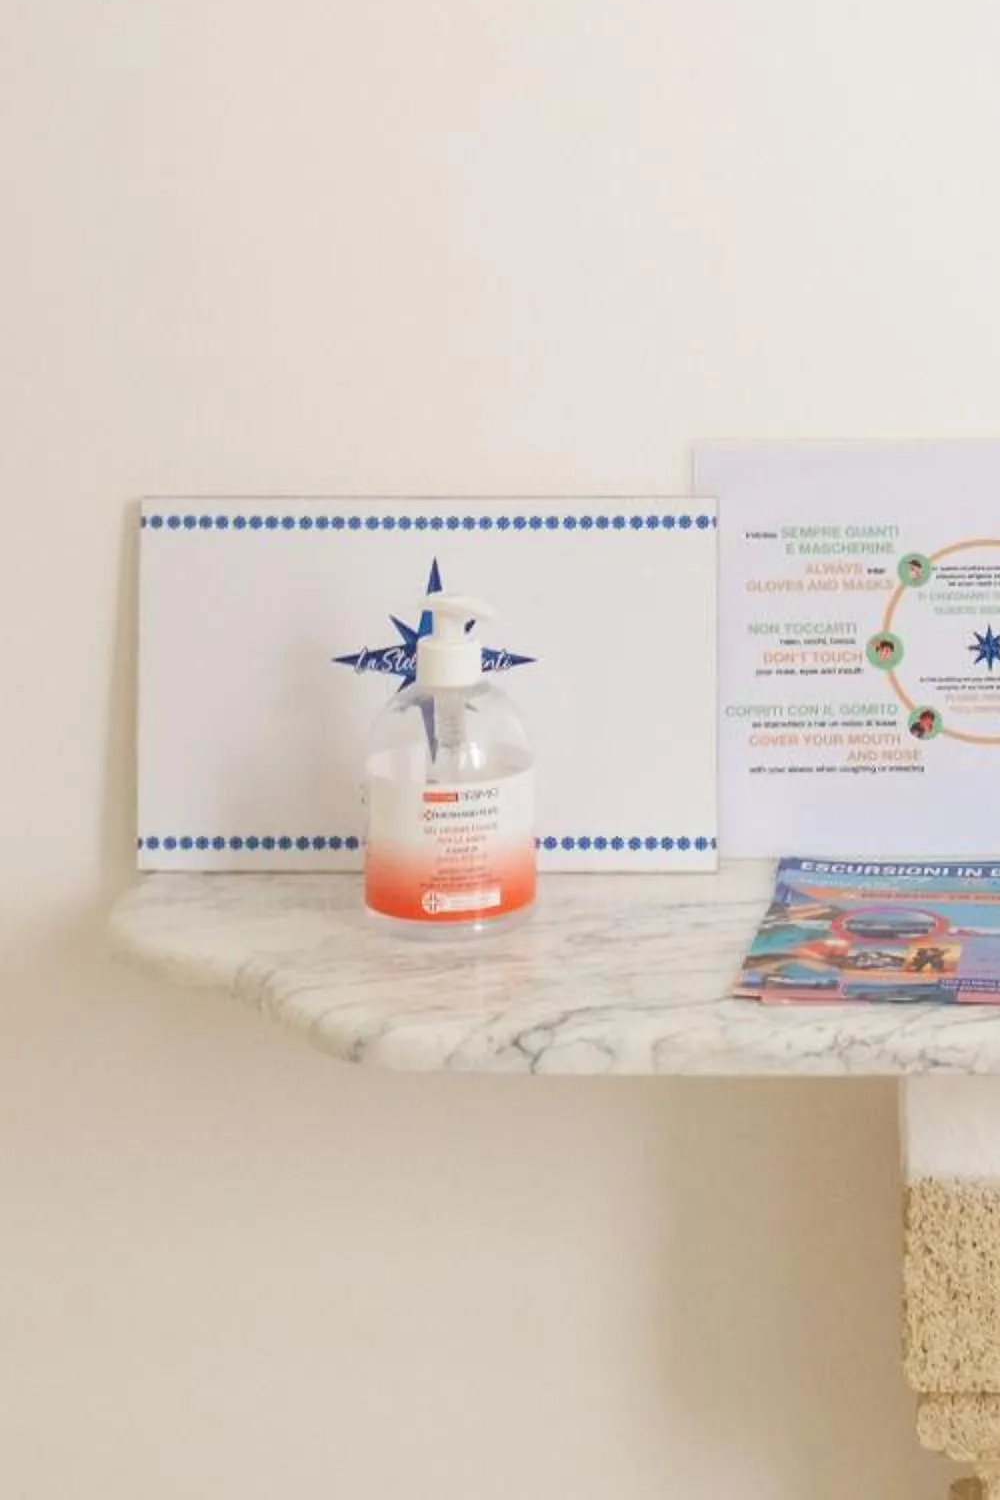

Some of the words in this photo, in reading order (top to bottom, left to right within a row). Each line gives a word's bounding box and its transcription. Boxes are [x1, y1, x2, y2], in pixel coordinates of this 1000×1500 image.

[781, 526, 842, 539] SEMPRE
[845, 525, 900, 539] GUANTI
[785, 543, 796, 555] E
[799, 542, 896, 555] MASCHERINE
[805, 563, 863, 575] ALWAYS
[745, 580, 806, 592] GLOVES
[808, 579, 839, 591] AND
[843, 579, 894, 591] MASKS
[747, 623, 779, 635] NON
[785, 623, 858, 635] TOCCARTI
[763, 651, 808, 664] DON'T
[812, 651, 864, 664] TOUCH
[725, 704, 783, 717] COPRITI
[787, 704, 819, 716] CON
[823, 704, 834, 716] IL
[839, 703, 898, 716] GOMITO
[749, 733, 799, 746] COVER
[802, 733, 844, 746] YOUR
[847, 732, 901, 745] MOUTH
[848, 749, 879, 761] AND
[881, 748, 919, 761] NOSE
[800, 861, 949, 877] ESCURSIONI
[957, 867, 983, 877] IN
